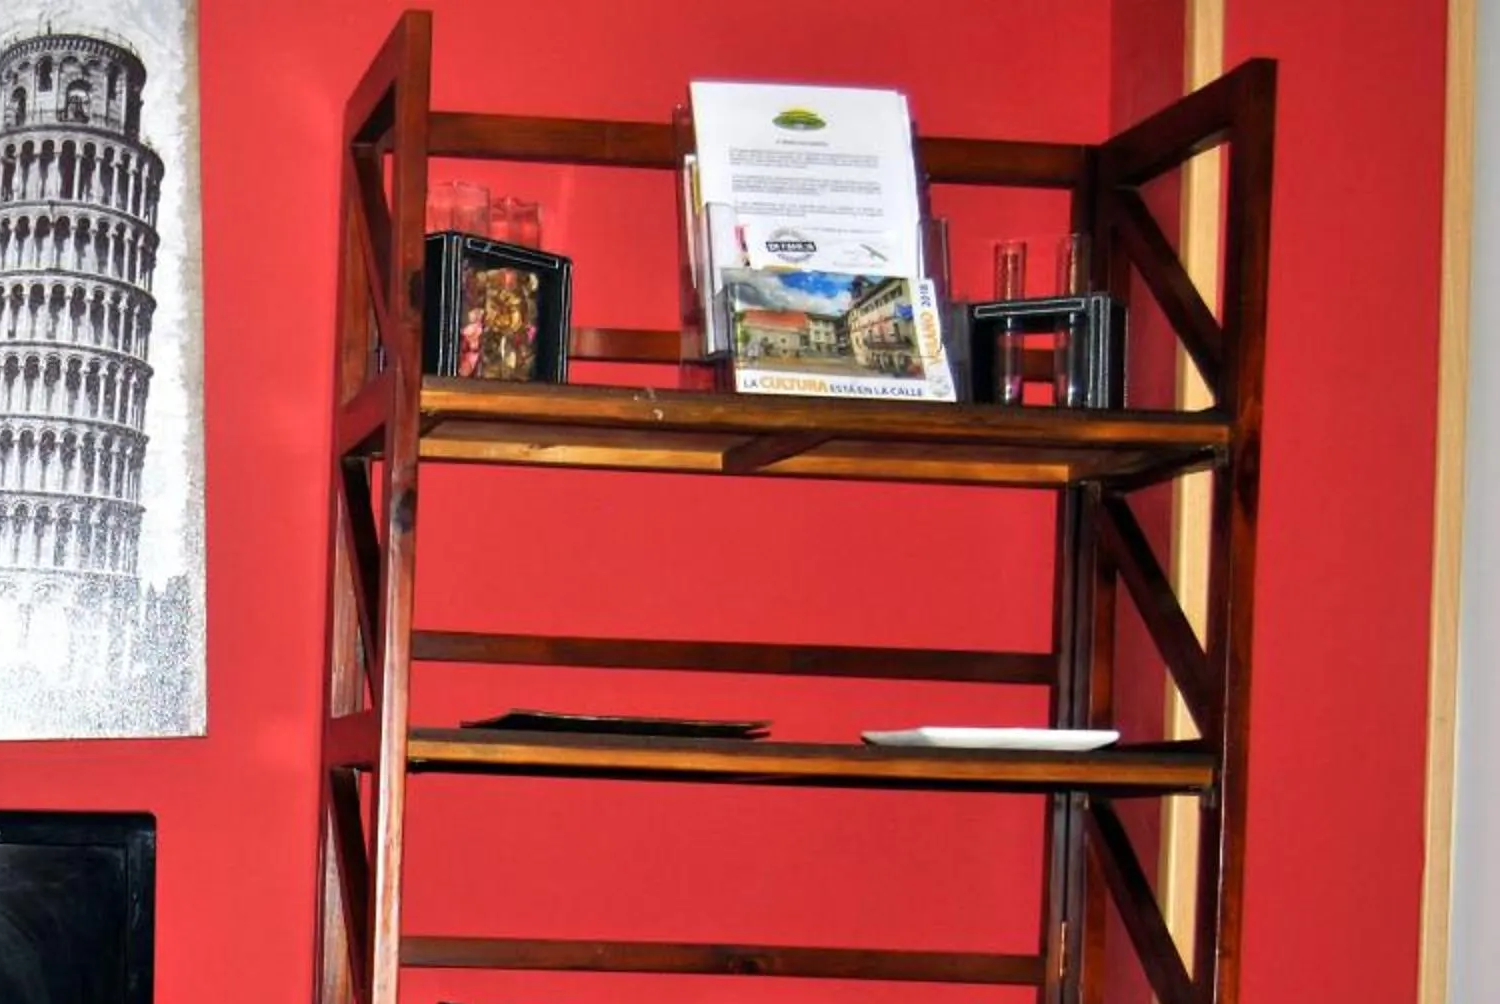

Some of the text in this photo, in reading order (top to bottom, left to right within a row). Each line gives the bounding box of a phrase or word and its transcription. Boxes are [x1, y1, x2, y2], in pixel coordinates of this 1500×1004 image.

[743, 378, 758, 389] LA
[759, 376, 829, 393] CULTURA
[889, 387, 923, 397] CALLE
